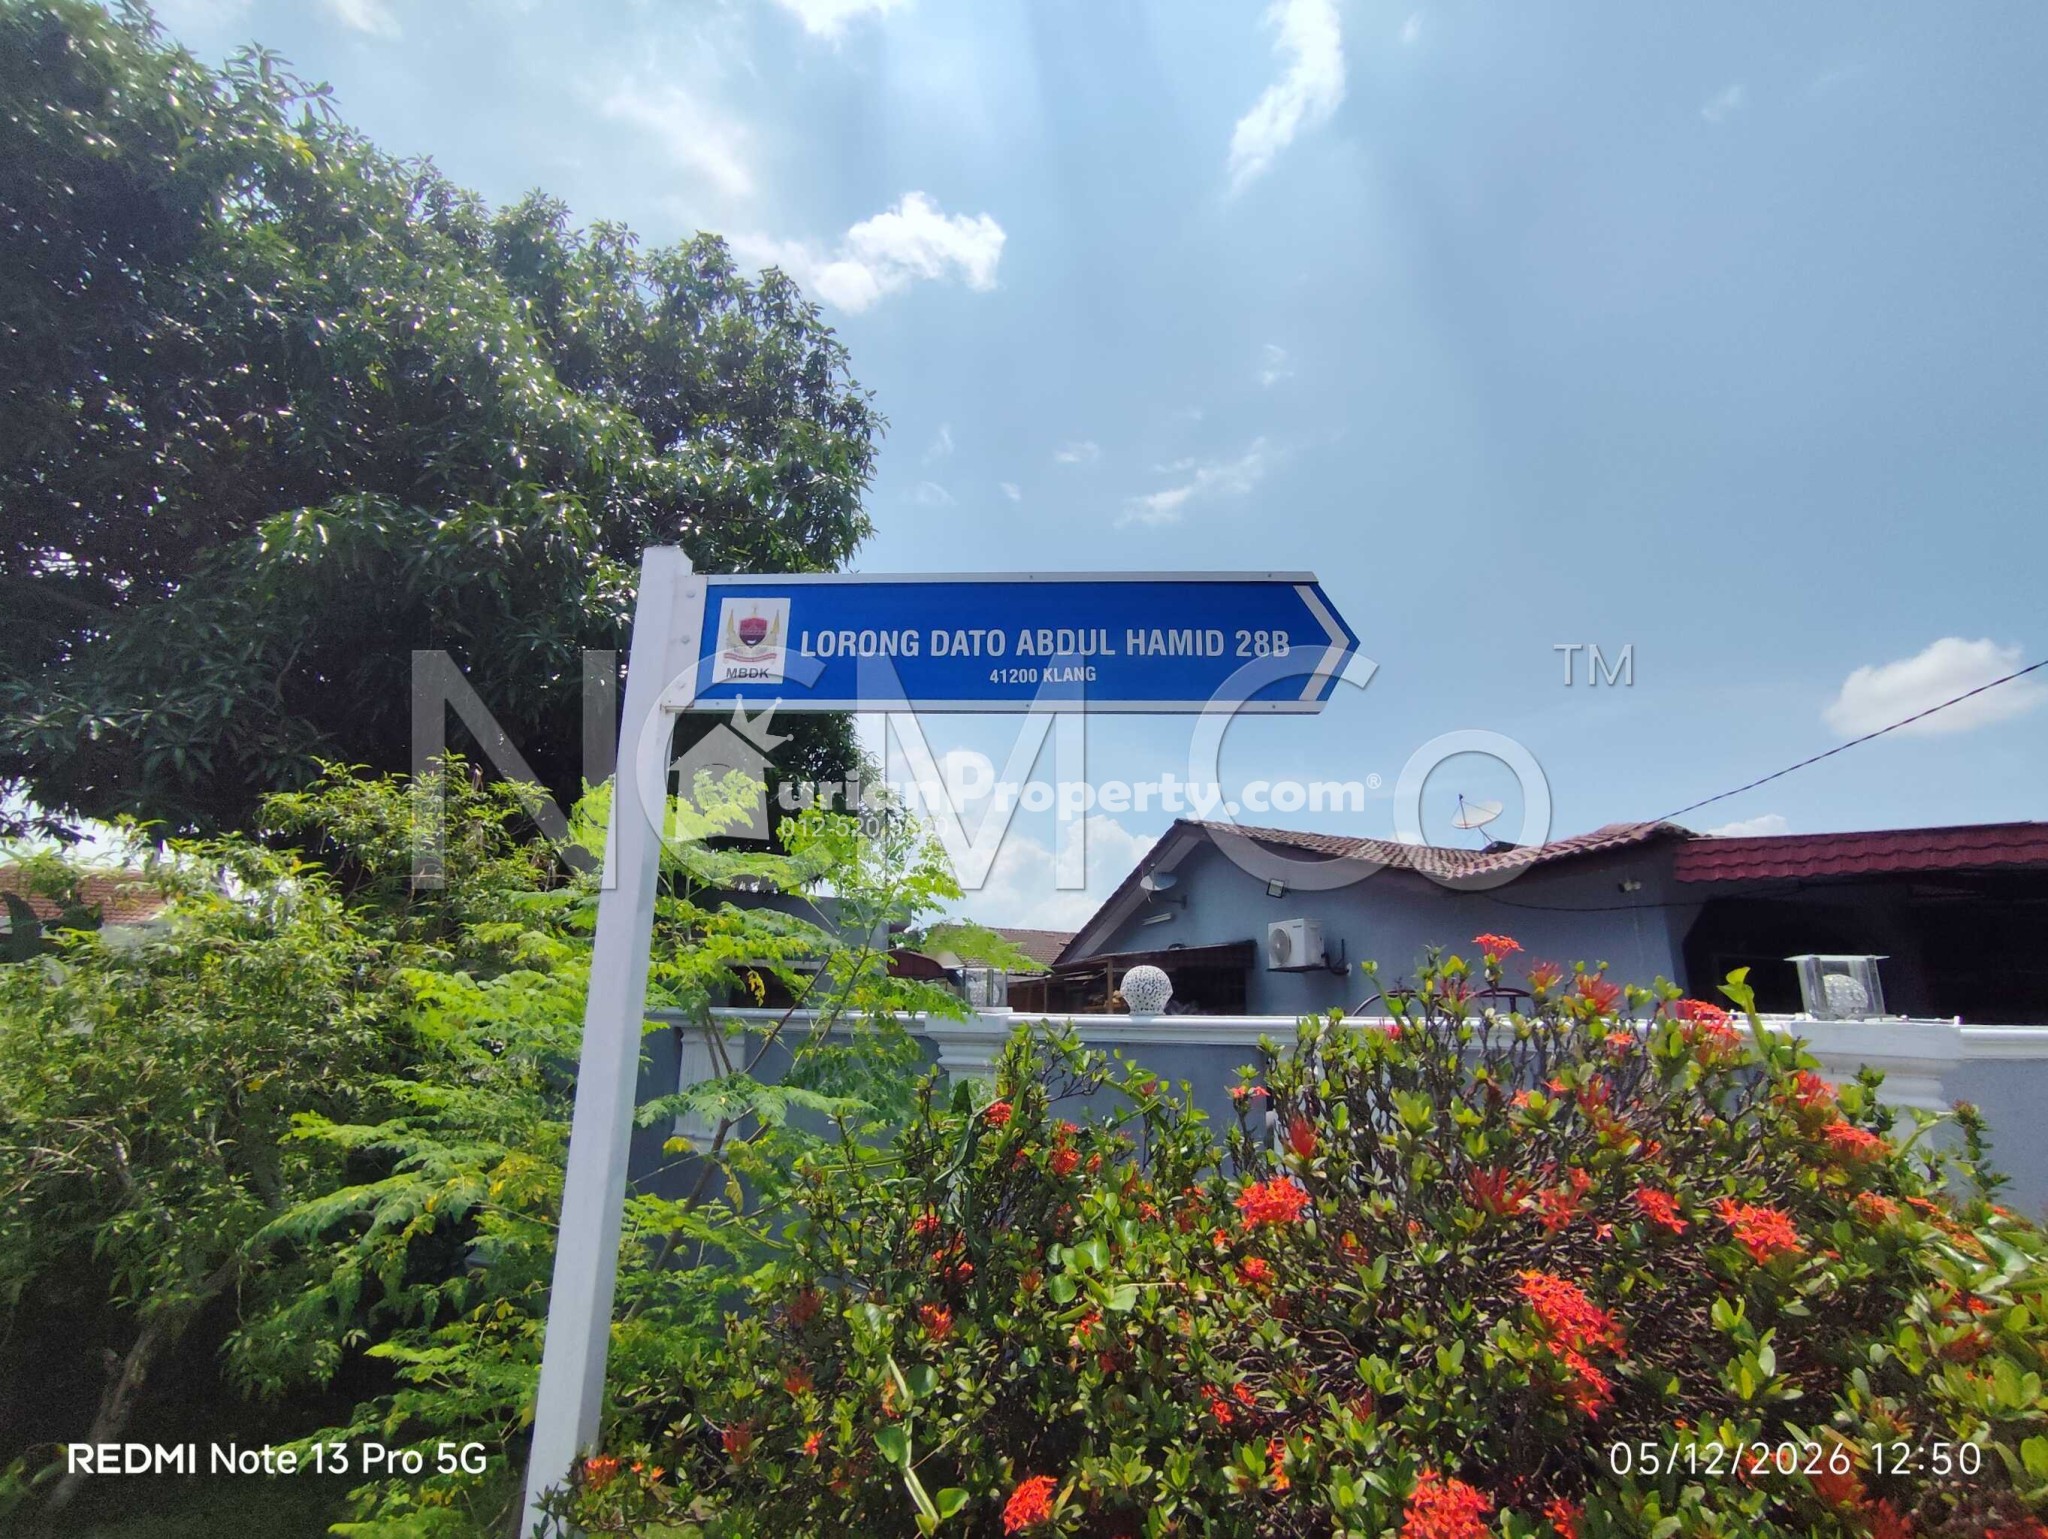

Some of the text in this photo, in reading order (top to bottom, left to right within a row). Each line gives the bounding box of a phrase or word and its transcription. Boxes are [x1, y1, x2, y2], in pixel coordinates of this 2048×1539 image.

[800, 629, 1291, 657] LORONG DATO ABDUL HAMID 28B
[726, 667, 770, 679] MBDK
[989, 666, 1097, 684] 41200 KLANG
